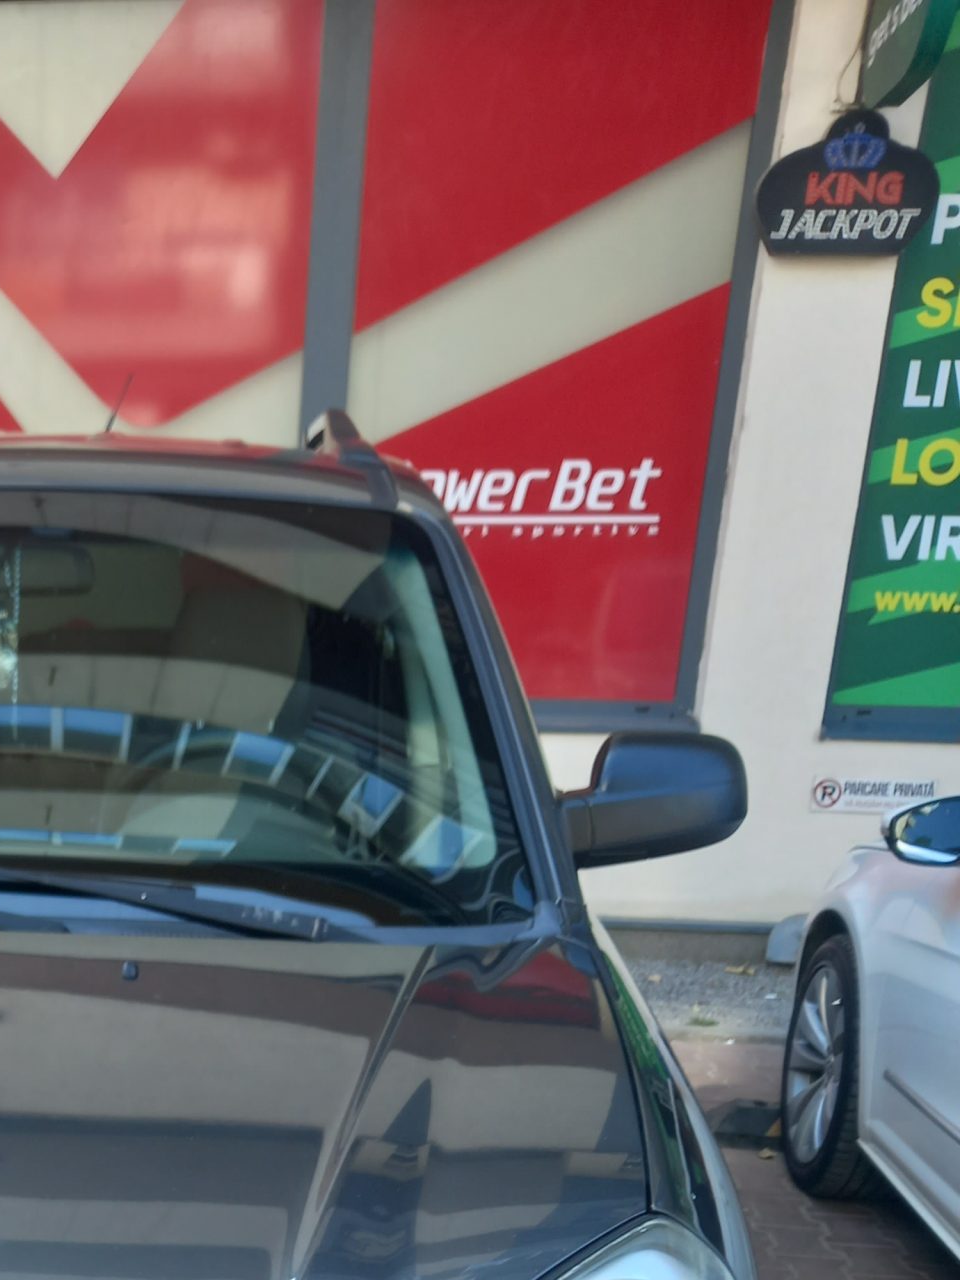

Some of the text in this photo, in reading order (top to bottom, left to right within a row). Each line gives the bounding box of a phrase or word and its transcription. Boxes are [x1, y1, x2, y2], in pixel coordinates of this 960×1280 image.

[805, 170, 905, 206] KING
[770, 208, 922, 240] JACKPOT
[916, 277, 960, 329] S
[549, 457, 662, 511] Bet
[843, 781, 891, 797] PARCARE
